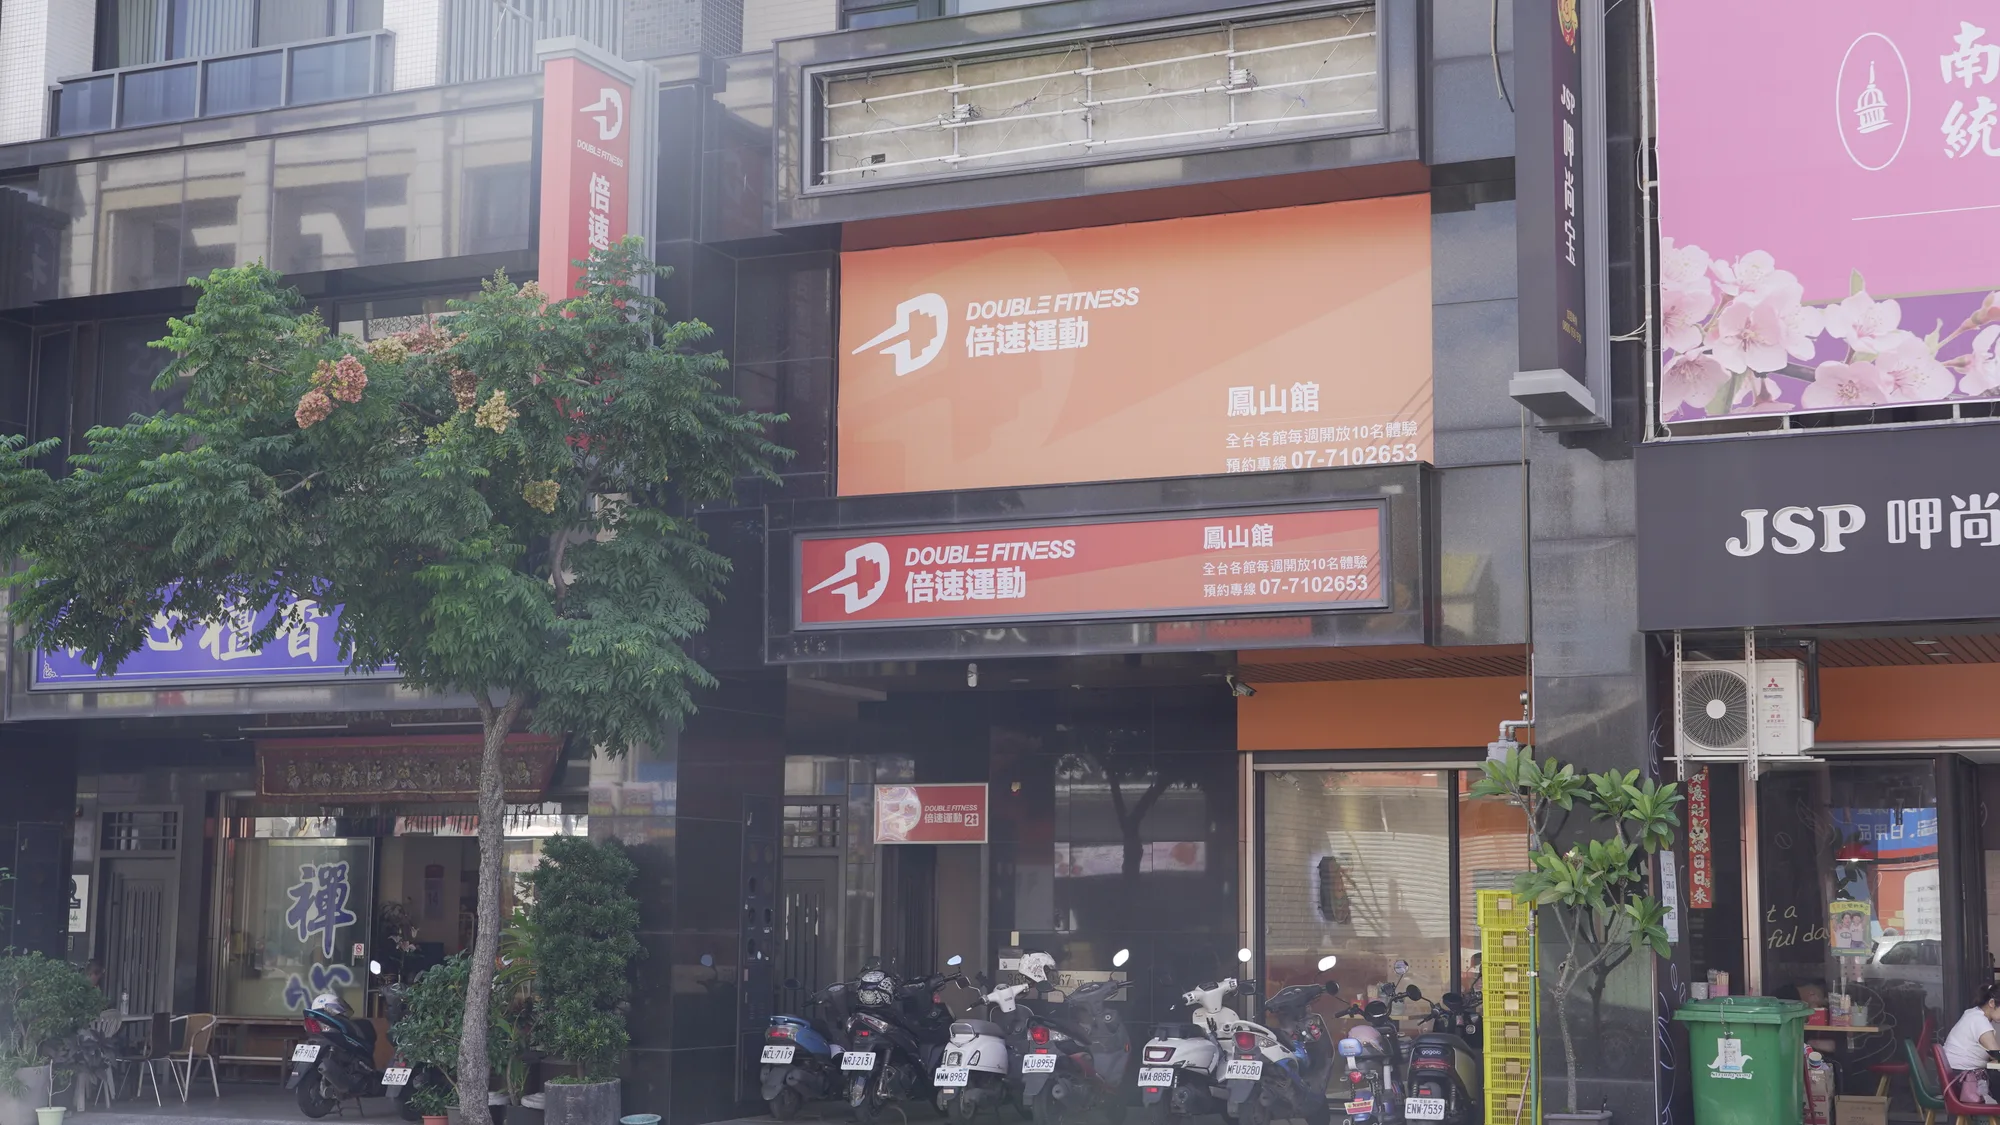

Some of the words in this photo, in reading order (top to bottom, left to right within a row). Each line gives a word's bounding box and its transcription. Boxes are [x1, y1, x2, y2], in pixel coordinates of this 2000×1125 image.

[1561, 84, 1576, 115] JSP
[577, 139, 601, 157] DOUBLE
[601, 151, 624, 168] FITNESS
[966, 295, 1052, 320] DOUBLE
[1054, 287, 1140, 313] FITNESS
[966, 316, 1089, 358] 倍速運動
[1227, 381, 1320, 417] 鳳山館
[1226, 455, 1287, 474] 預約專線
[1291, 443, 1418, 469] 07-7102653
[1203, 523, 1274, 549] 鳳山館
[1725, 503, 1866, 557] JSP
[1887, 492, 2000, 549] 呷尚
[905, 543, 990, 566] DOUBLE
[991, 539, 1076, 562] FITNESS
[905, 565, 1026, 603] 倍速運動
[1204, 582, 1256, 597] 預約專線
[1260, 574, 1368, 595] 07-7102653
[924, 812, 962, 823] 倍速運動
